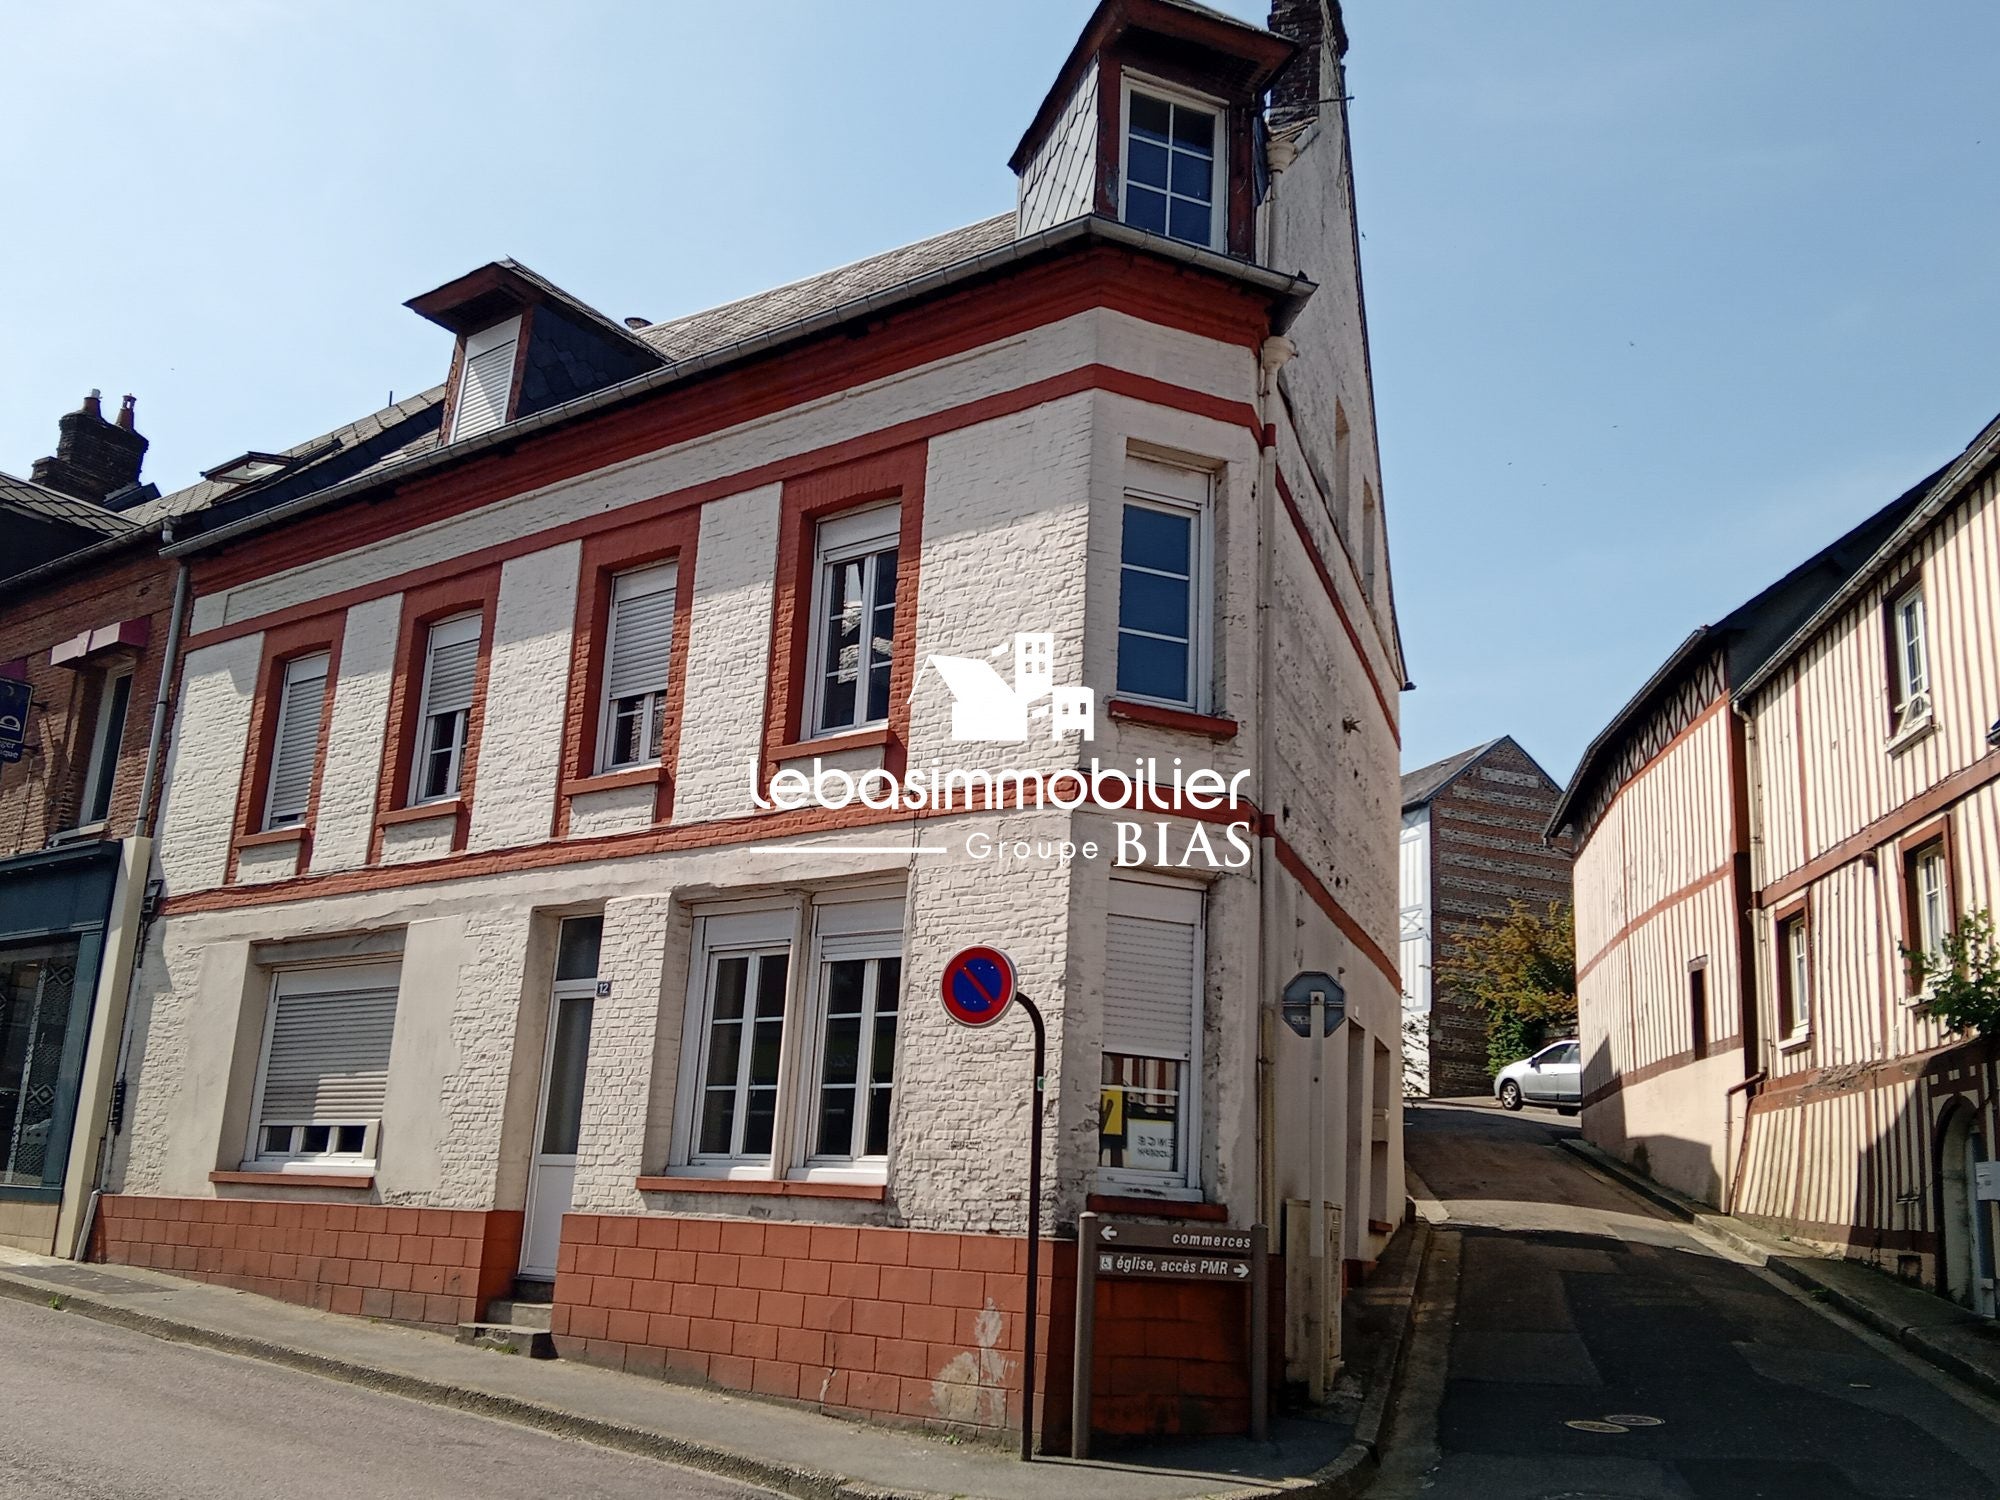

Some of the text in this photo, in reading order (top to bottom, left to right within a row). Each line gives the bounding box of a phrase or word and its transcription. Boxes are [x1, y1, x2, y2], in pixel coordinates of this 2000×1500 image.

[599, 983, 609, 994] 12
[1172, 1233, 1251, 1248] commerces
[1116, 1256, 1228, 1275] église, accès PMR
